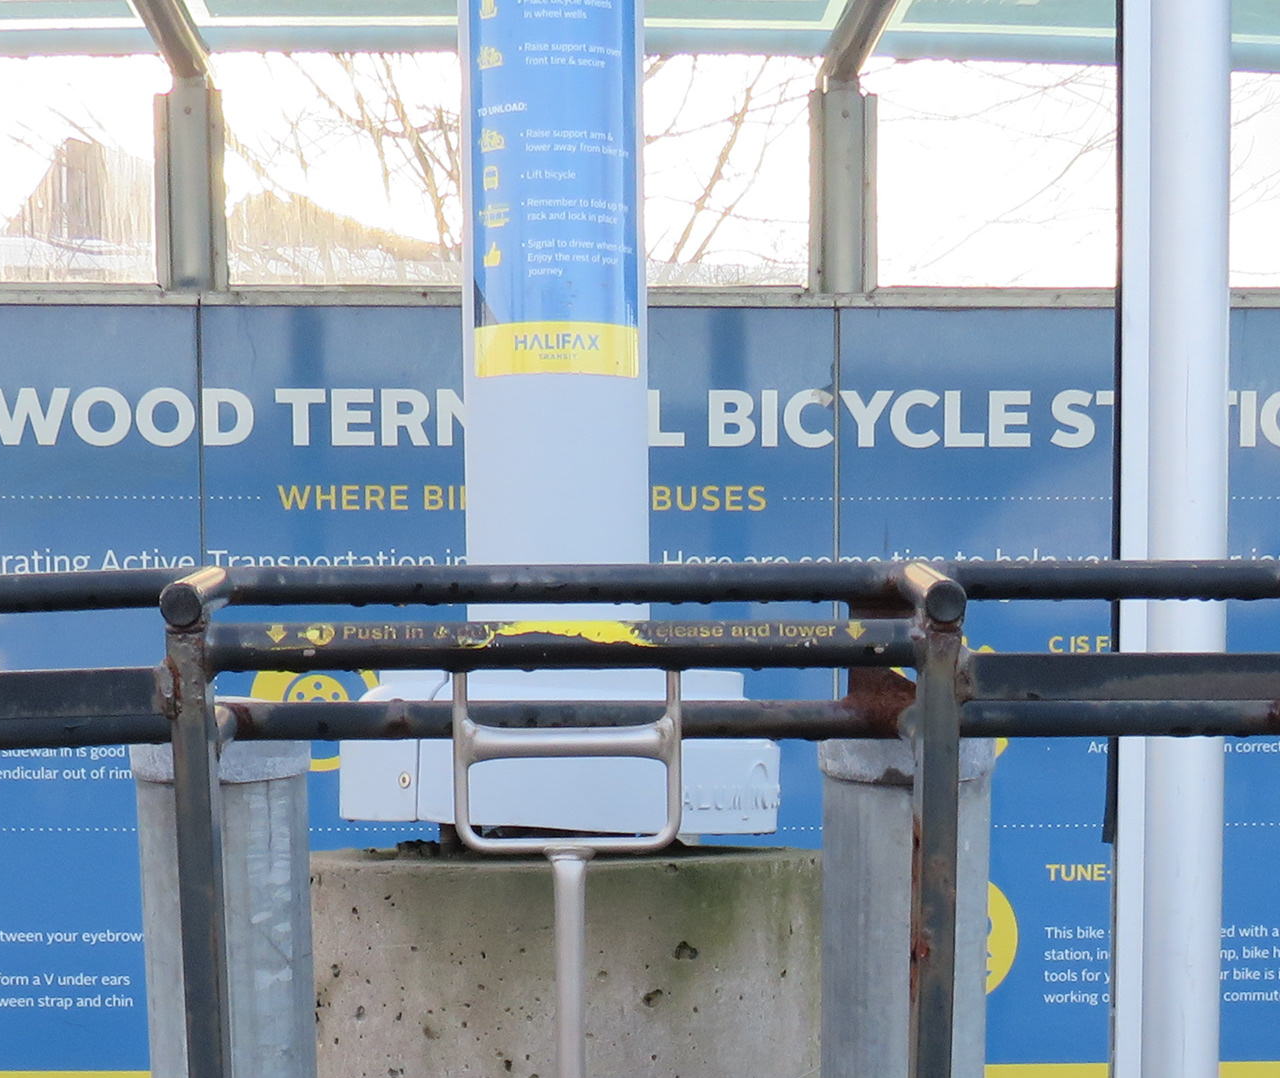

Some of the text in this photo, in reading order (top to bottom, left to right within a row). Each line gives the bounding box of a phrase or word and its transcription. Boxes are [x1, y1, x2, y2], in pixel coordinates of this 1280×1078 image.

[524, 9, 588, 19] in wheel wells
[524, 42, 621, 57] Raise support arm over
[525, 56, 606, 68] front tire & secure
[477, 102, 528, 118] TO UNLOAD:
[526, 129, 614, 142] Raise support arm &
[525, 143, 551, 152] lower
[553, 144, 577, 154] away
[579, 143, 601, 153] from
[526, 170, 577, 182] Lift bicycle
[527, 198, 577, 208] Remember
[579, 199, 589, 208] to
[590, 199, 607, 210] fold
[527, 211, 618, 225] rack and lock in place
[527, 238, 555, 250] Signal
[557, 240, 567, 249] to
[569, 239, 594, 249] driver
[596, 241, 617, 251] when
[527, 253, 619, 266] Enjoy the rest of your
[527, 266, 563, 278] journey
[514, 333, 600, 351] HALIFAX
[707, 388, 1033, 449] BICYCLE
[277, 485, 410, 511] WHERE
[652, 485, 768, 512] BUSES
[101, 549, 195, 572] Active
[343, 624, 397, 640] Push
[405, 624, 424, 639] in
[730, 623, 770, 638] and
[779, 623, 837, 638] lower
[1048, 636, 1064, 653] C
[1070, 636, 1091, 653] IS
[76, 746, 87, 758] is
[90, 745, 126, 760] good
[62, 767, 87, 780] out
[89, 766, 107, 780] of
[46, 931, 77, 945] your
[81, 929, 145, 945] eyebrow
[1044, 926, 1073, 940] This
[1077, 926, 1105, 940] bike
[1238, 925, 1268, 939] with
[1271, 927, 1280, 939] a
[1044, 948, 1094, 963] station,
[1242, 946, 1270, 959] bike
[32, 976, 41, 986] a
[43, 973, 55, 986] V
[57, 972, 98, 986] under
[101, 975, 131, 986] ears
[1044, 969, 1078, 983] tools
[1080, 969, 1102, 983] for
[1233, 967, 1261, 981] bike
[1264, 968, 1275, 981] is
[37, 996, 74, 1010] strap
[76, 994, 102, 1008] and
[104, 994, 134, 1008] chin
[1043, 990, 1099, 1006] working
